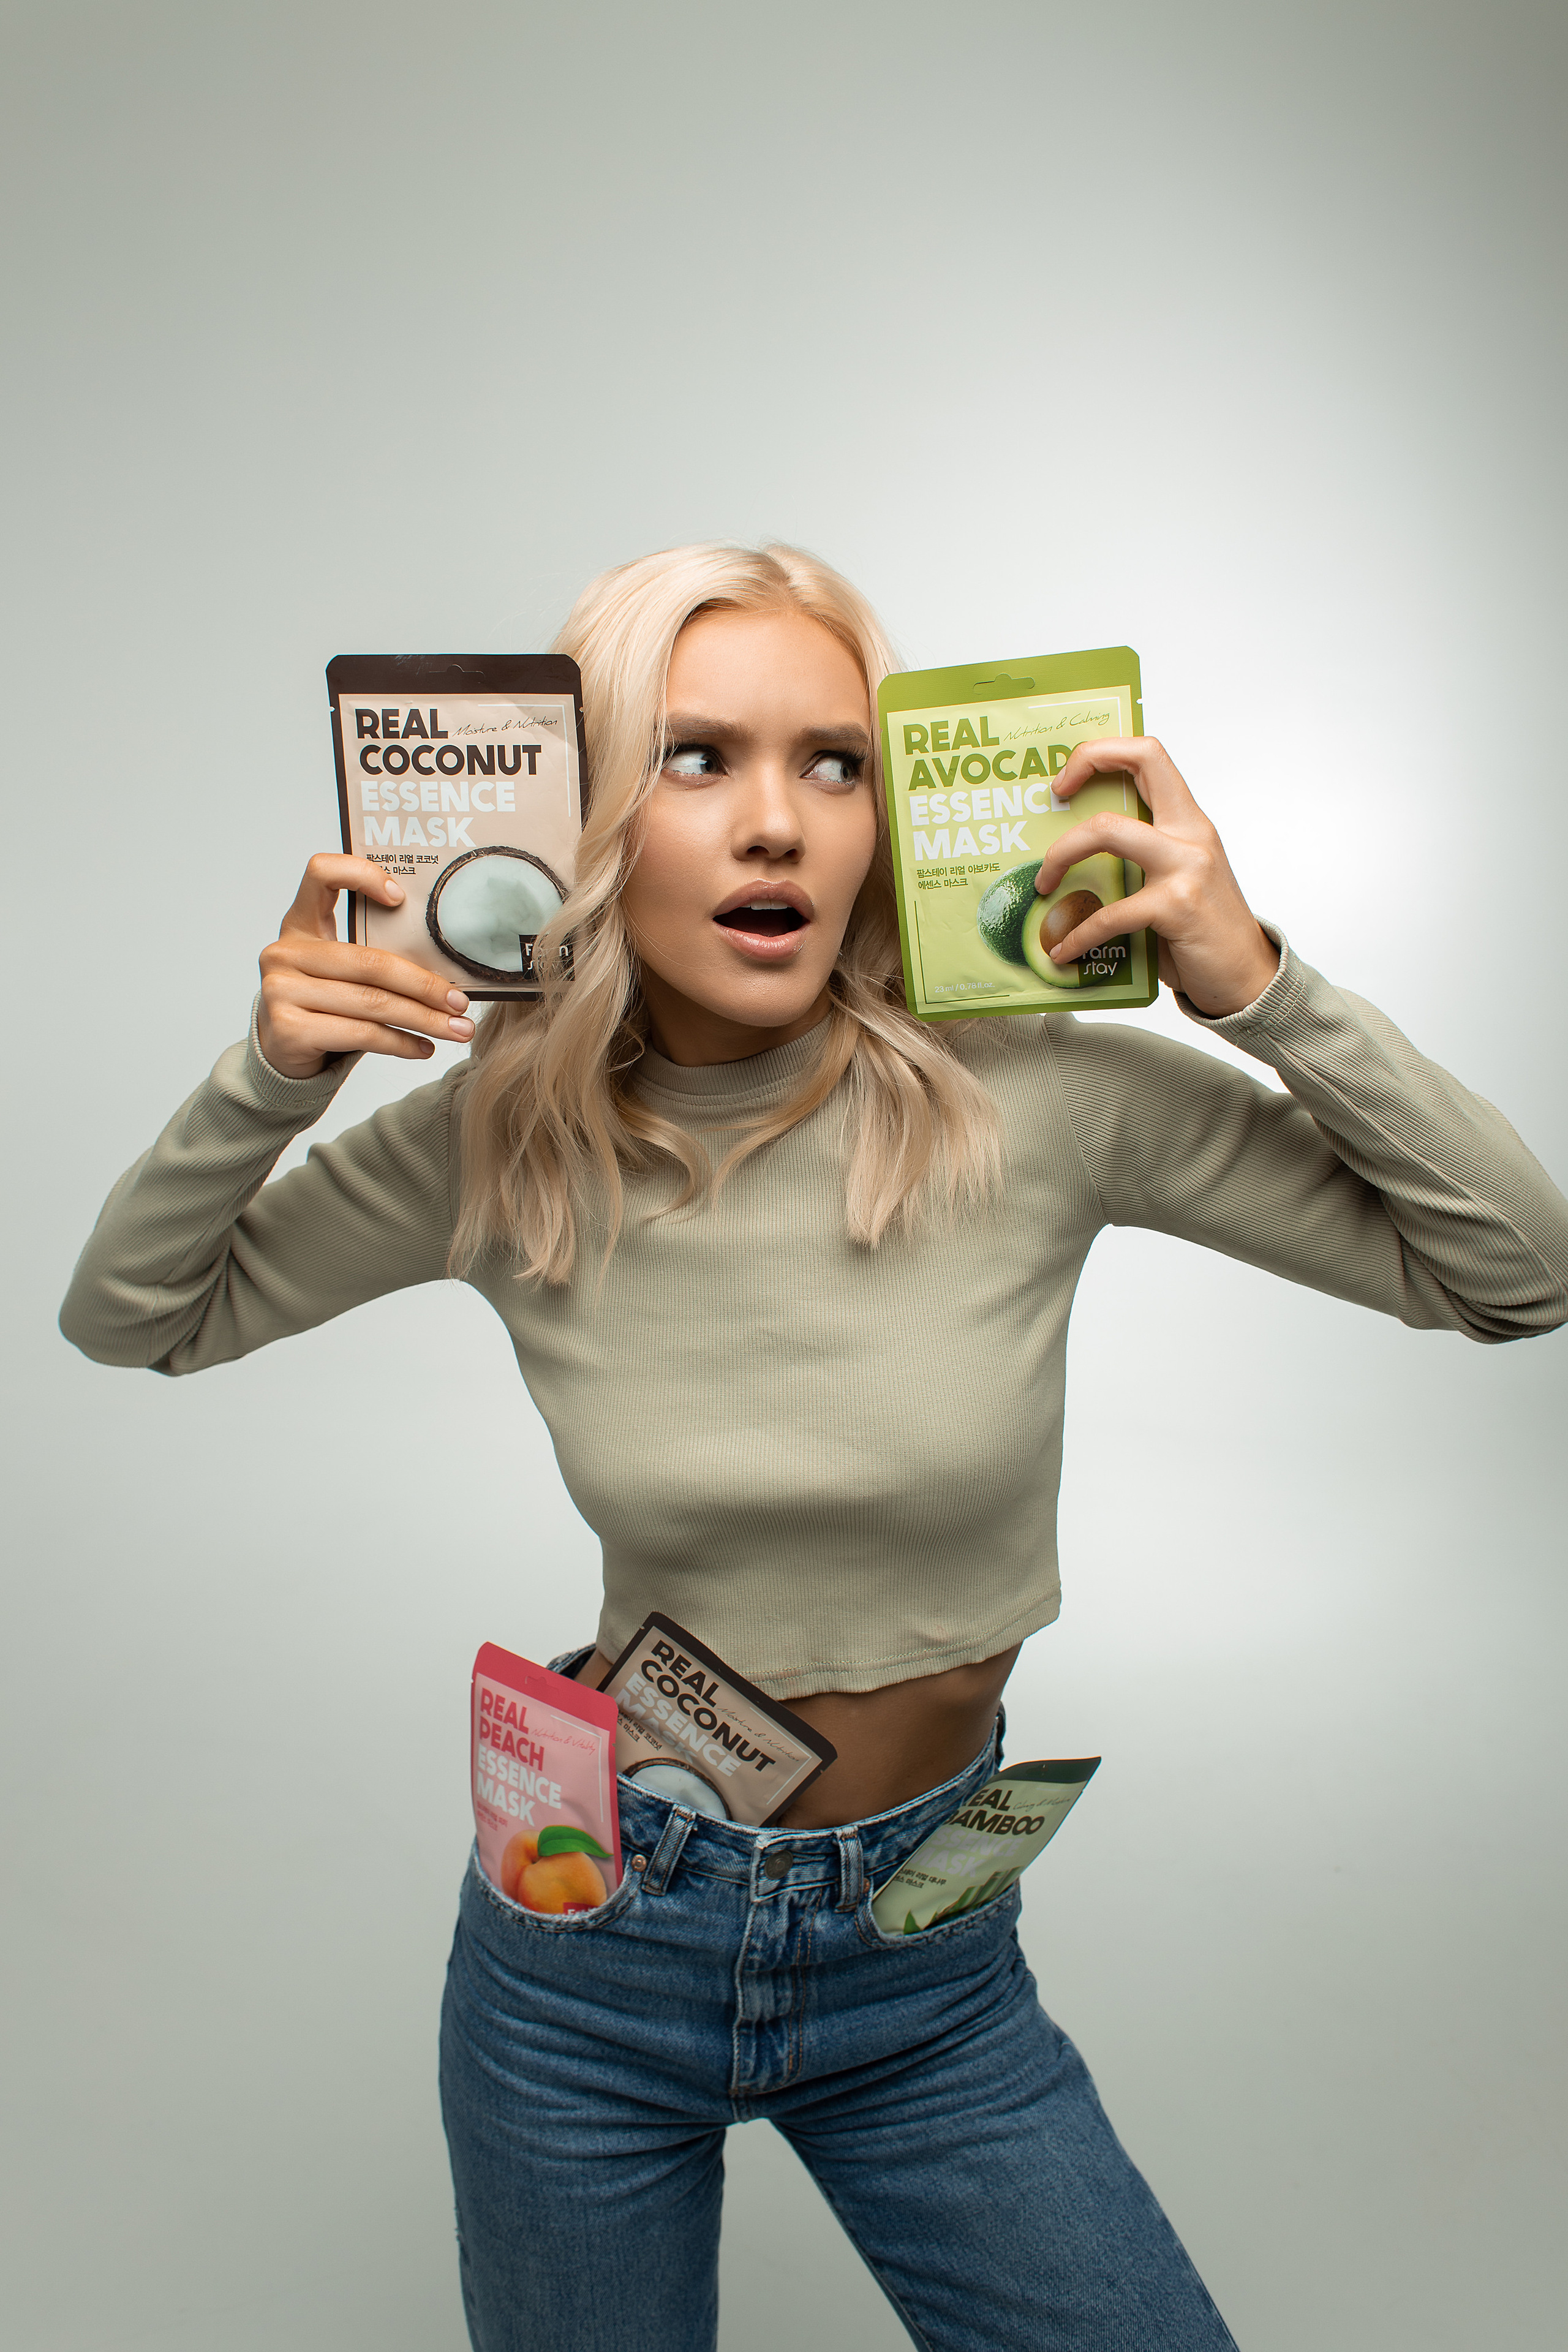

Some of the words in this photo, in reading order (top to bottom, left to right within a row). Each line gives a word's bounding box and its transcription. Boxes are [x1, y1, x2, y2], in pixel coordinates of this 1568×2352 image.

[355, 709, 448, 739] REAL
[452, 723, 497, 737] Moisture
[501, 720, 512, 731] &
[513, 716, 558, 729] Nutrition
[903, 716, 1000, 755] REAL
[1003, 723, 1052, 741] Nutrition
[1056, 717, 1067, 729] &
[1069, 710, 1110, 725] Calming
[360, 744, 541, 775] COCONUT
[908, 741, 1088, 791] AVOCAD
[360, 780, 516, 812] ESSENCE
[364, 816, 477, 848] MASK
[913, 821, 1031, 861] MASK
[393, 866, 416, 875] 마스크
[399, 854, 413, 864] 리얼
[416, 855, 439, 864] 코코넛
[917, 867, 947, 878] 팜스테이
[950, 865, 965, 875] 리얼
[968, 862, 1000, 873] 아보카도
[919, 880, 941, 889] 에센스
[944, 878, 968, 888] 마스크
[1084, 962, 1117, 976] stay
[651, 1640, 719, 1708] REAL
[480, 1687, 529, 1734] REAL
[615, 1689, 698, 1764] MASK
[625, 1672, 741, 1776] ESSENCE
[641, 1659, 776, 1772] COCONUT
[480, 1716, 544, 1771] PEACH
[478, 1744, 562, 1809] ESSENCE
[477, 1771, 535, 1826] MASK
[963, 1789, 1013, 1811] EAL
[931, 1827, 1025, 1856] SSENCE
